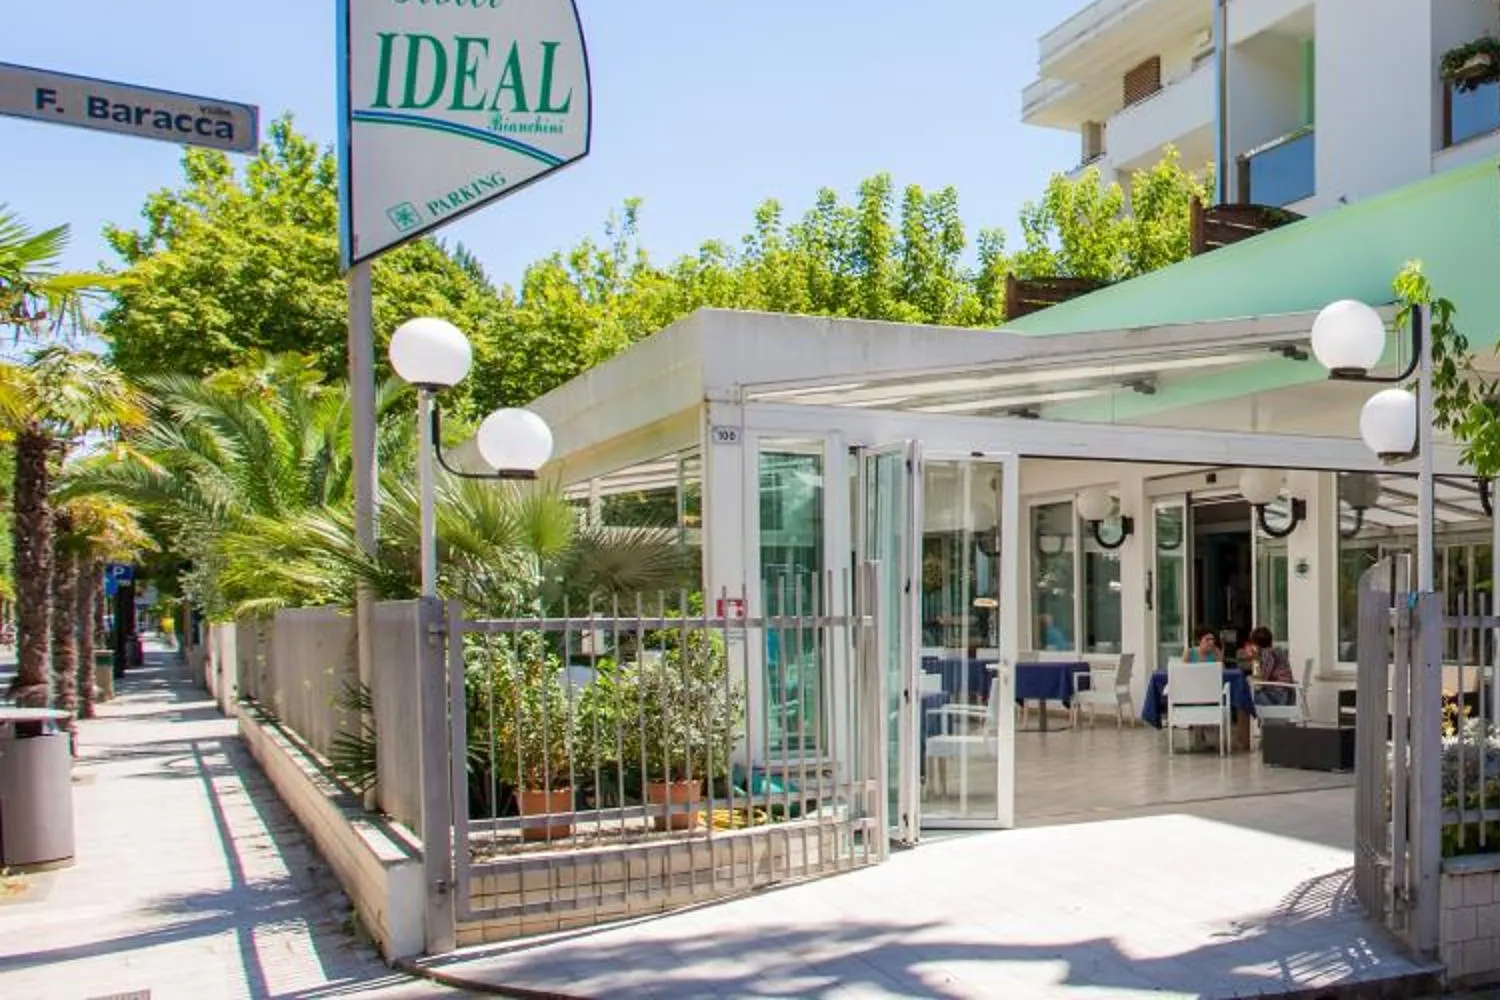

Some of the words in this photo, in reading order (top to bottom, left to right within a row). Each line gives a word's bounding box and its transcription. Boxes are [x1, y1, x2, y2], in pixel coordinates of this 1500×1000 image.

[369, 32, 572, 113] IDEAL
[36, 87, 64, 112] F.
[87, 95, 234, 142] Baracca
[427, 172, 507, 216] PARKING
